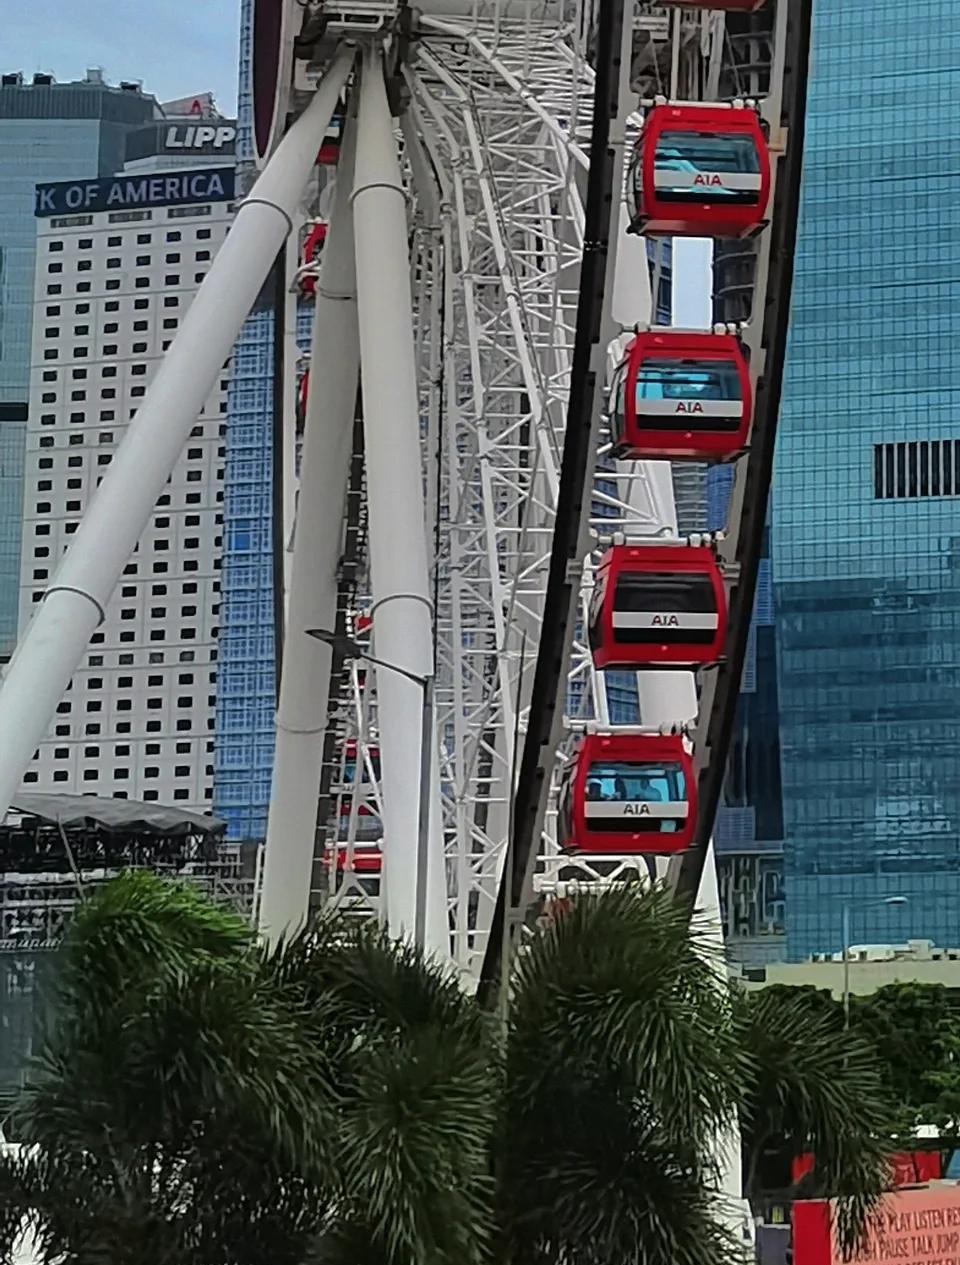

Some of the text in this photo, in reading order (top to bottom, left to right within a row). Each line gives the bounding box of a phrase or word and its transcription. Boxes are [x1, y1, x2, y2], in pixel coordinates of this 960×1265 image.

[165, 126, 236, 148] LIPP
[694, 174, 722, 186] AIA
[35, 174, 225, 210] K OF AMERICA
[675, 401, 703, 413] AIA
[651, 615, 679, 626] AIA
[623, 804, 650, 816] AIA
[888, 1211, 912, 1233] PLAY
[914, 1208, 945, 1230] LISTEN
[880, 1236, 909, 1258] PAUSE
[911, 1233, 935, 1256] TALK
[937, 1231, 960, 1253] JUMP
